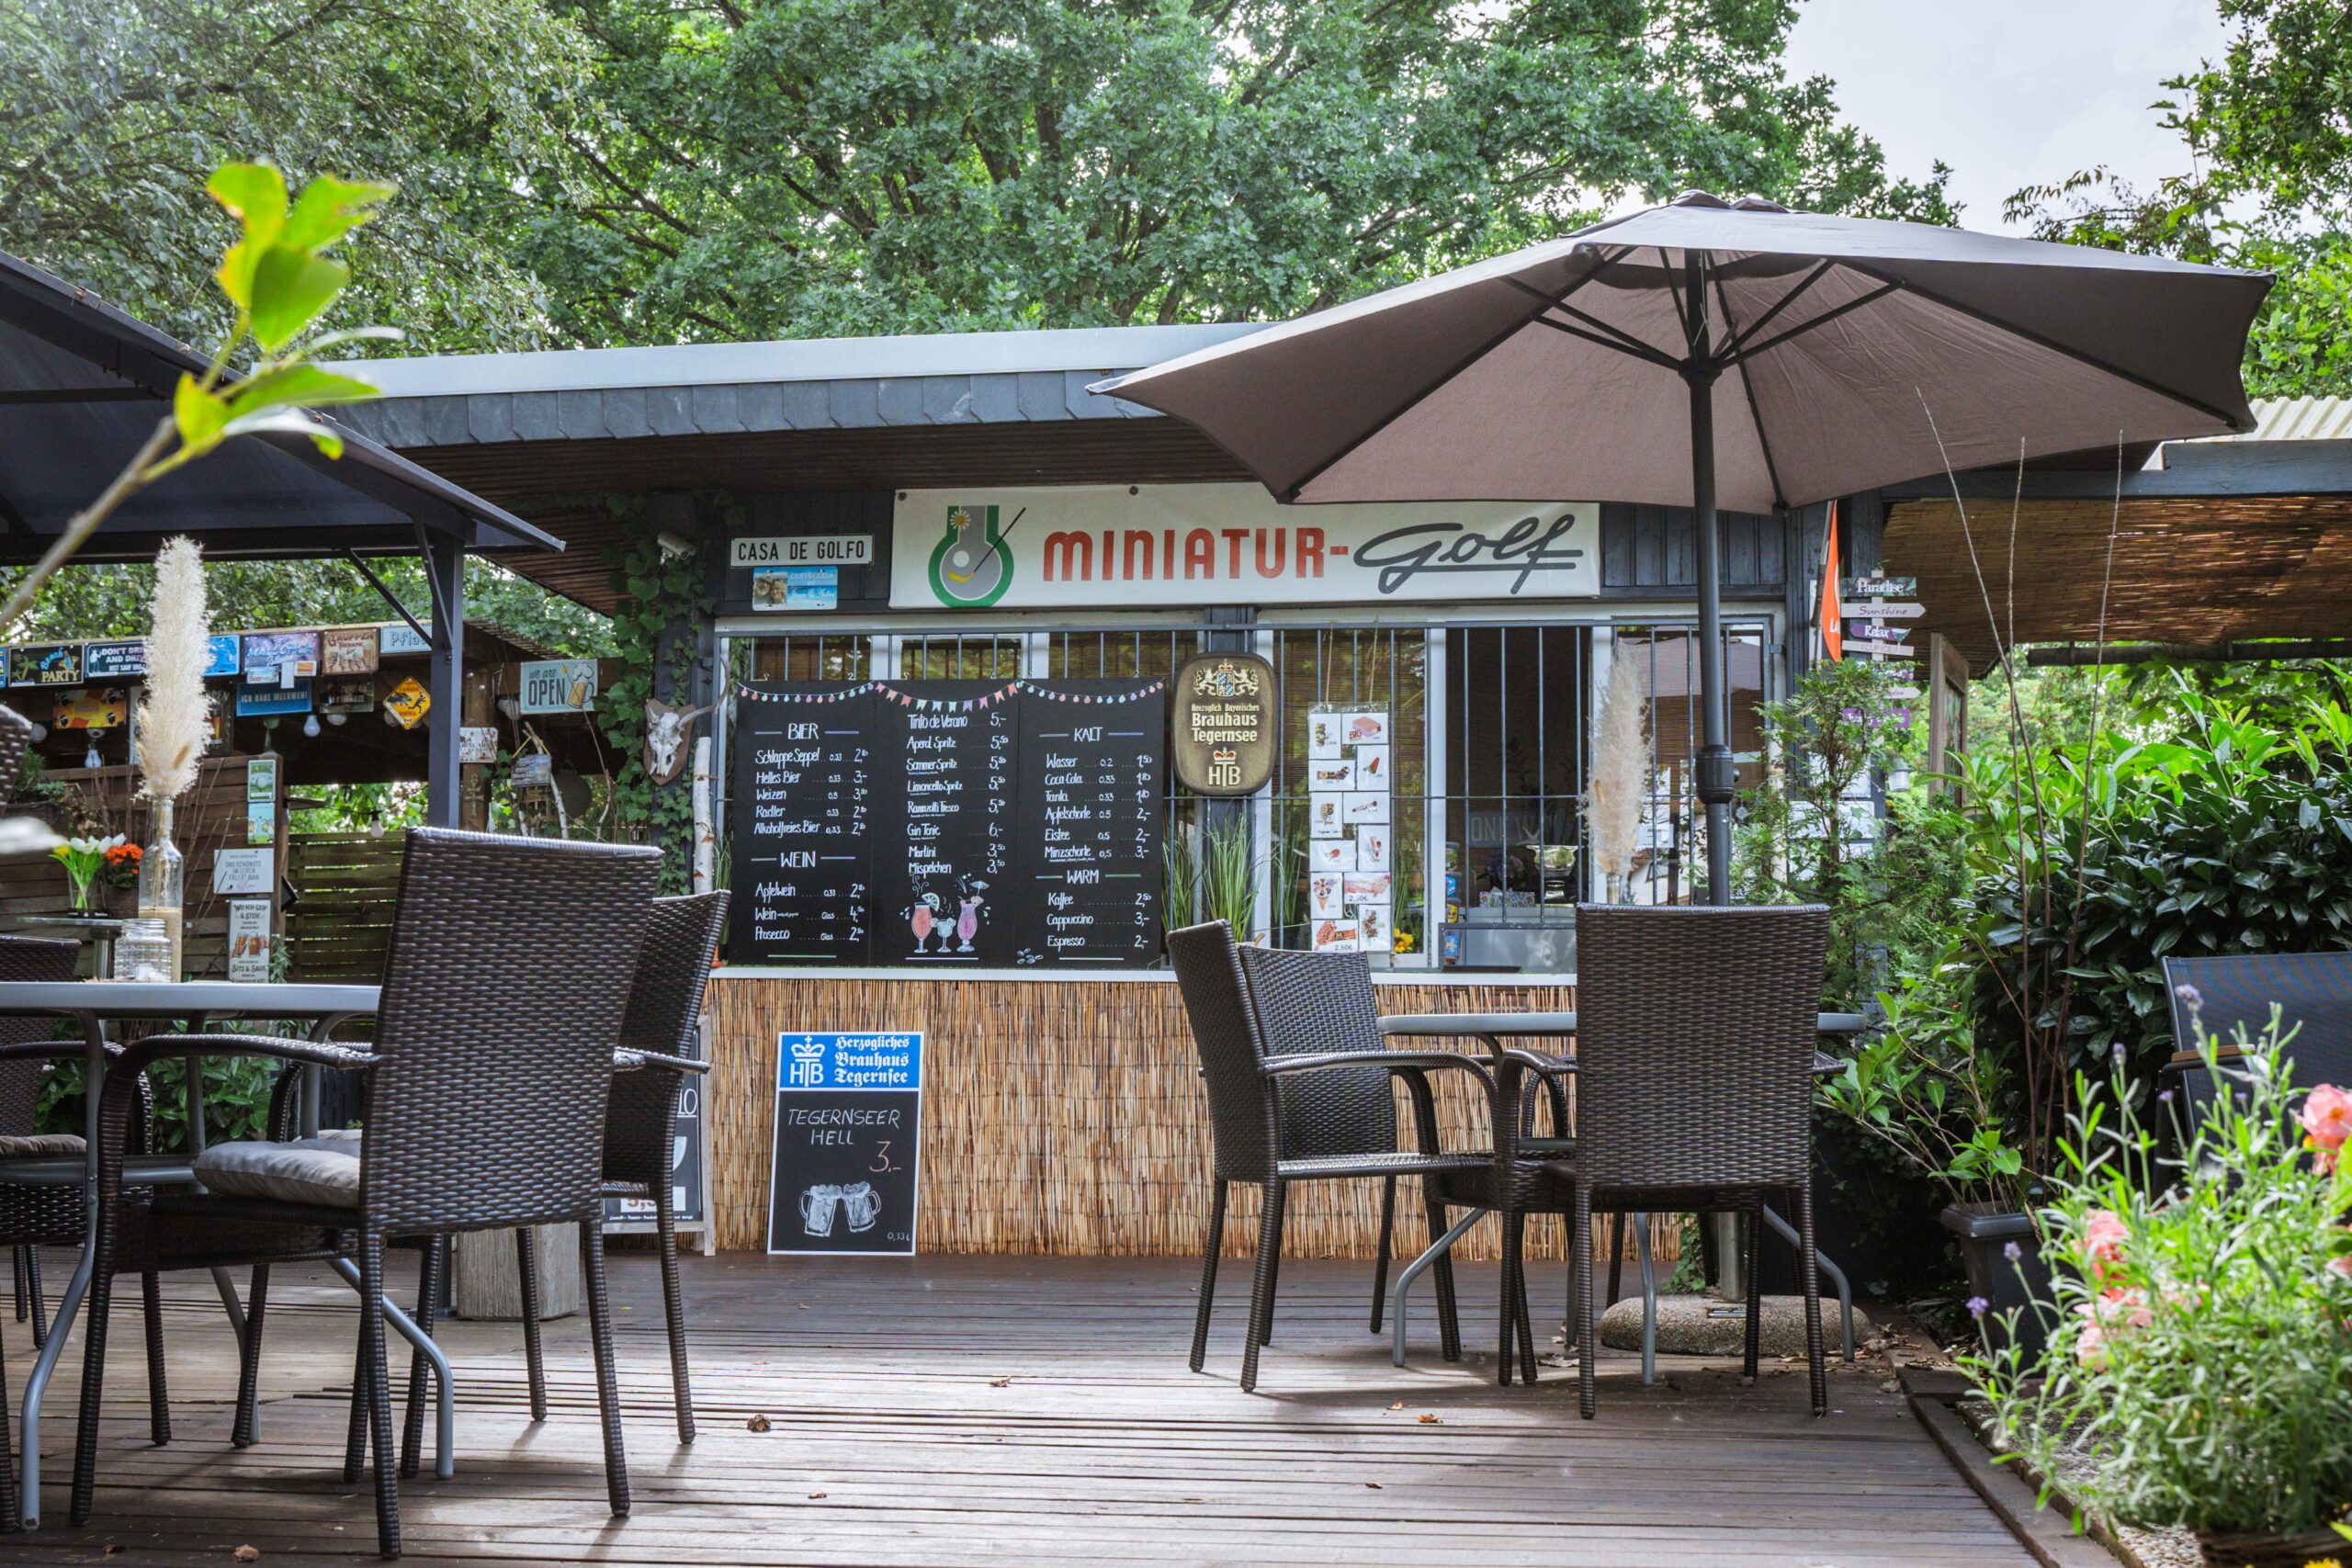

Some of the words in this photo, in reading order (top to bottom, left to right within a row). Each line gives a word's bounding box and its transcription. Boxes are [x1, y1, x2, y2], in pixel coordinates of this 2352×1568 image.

[739, 542, 779, 560] CASA
[789, 542, 808, 559] DE
[817, 540, 865, 559] GOLFO
[1352, 513, 1583, 594] Golf
[1857, 580, 1904, 593] Paradise
[1859, 606, 1908, 616] Sunshine
[390, 631, 426, 646] Pfia
[1864, 625, 1890, 638] Relax
[40, 647, 63, 670] Beach
[41, 671, 80, 682] PARTY
[543, 669, 557, 677] are
[242, 694, 252, 704] ICH
[528, 678, 565, 705] OPEN
[1192, 704, 1222, 713] Herzoglich
[1225, 704, 1260, 713] Bayerisches
[929, 715, 940, 728] de
[1192, 713, 1258, 727] Brauhaus
[787, 723, 819, 739] BIER
[1074, 727, 1102, 742] KALT
[1192, 728, 1258, 745] Tegernsee
[1046, 753, 1079, 768] Wasser
[756, 771, 781, 784] Helles
[783, 771, 801, 784] Bier
[1208, 761, 1241, 788] HTB
[756, 789, 786, 800] Weizen
[756, 805, 786, 818] Radler
[1045, 806, 1091, 825] Apfelschorle
[754, 821, 801, 838] Alkoholfreies
[802, 820, 820, 833] Bier
[907, 823, 921, 836] Gin
[922, 823, 941, 836] Tonic
[1045, 828, 1070, 841] Eistee
[909, 845, 936, 857] Martini
[1044, 845, 1091, 859] Minzschorle
[780, 851, 816, 868] WEIN
[909, 862, 952, 879] Mispelchen
[1067, 869, 1100, 884] WARM
[755, 882, 796, 903] Apfelwein
[1048, 892, 1074, 910] Kaffee
[755, 907, 776, 920] Wein
[1046, 913, 1094, 931] Cappuccino
[755, 926, 790, 941] Prosecco
[1047, 935, 1085, 953] Espresso
[835, 1036, 910, 1051] Herzogliches
[834, 1052, 910, 1070] Brauhaus
[789, 1058, 824, 1087] HTB
[788, 1109, 899, 1129] TEGERNSEER
[811, 1129, 854, 1145] HELL
